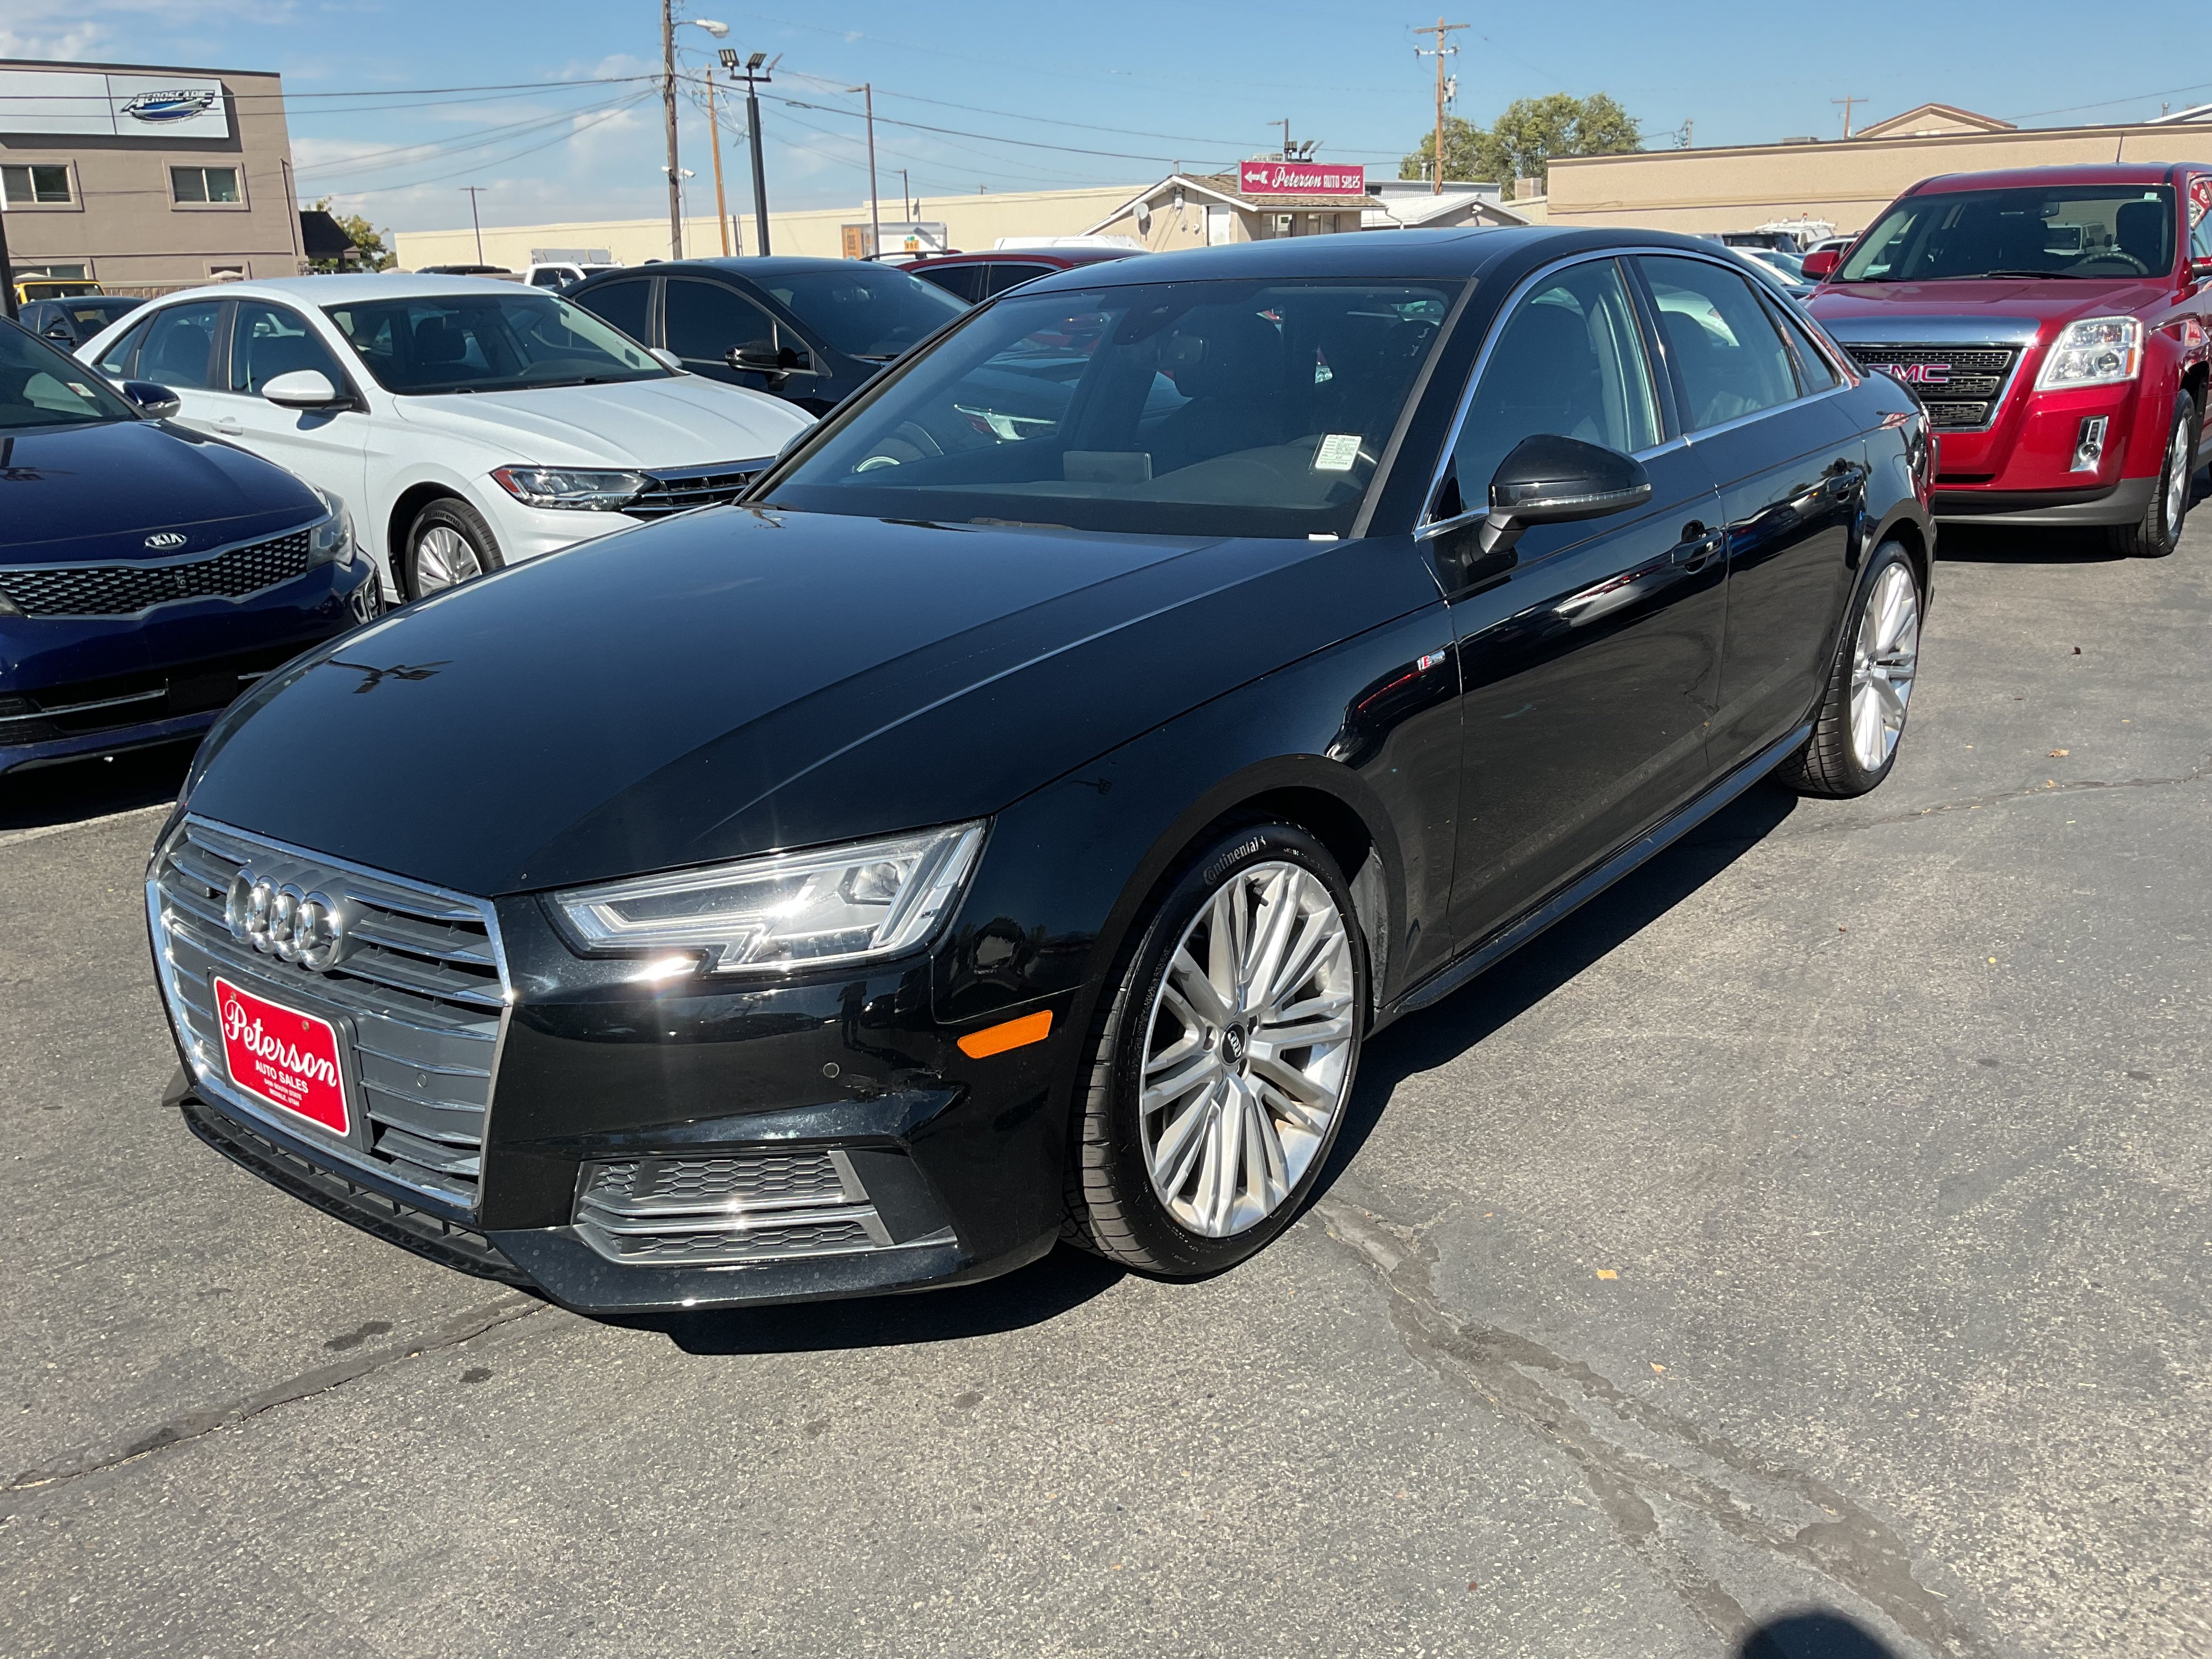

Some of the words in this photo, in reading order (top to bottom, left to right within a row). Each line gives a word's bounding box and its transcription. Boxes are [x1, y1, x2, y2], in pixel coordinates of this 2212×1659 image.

[1272, 166, 1322, 188] Peterson
[1323, 175, 1340, 188] AUTO
[1341, 175, 1361, 189] SALES
[150, 533, 183, 545] KIA
[1203, 836, 1259, 885] Continental
[225, 1000, 337, 1087] Peterson
[256, 1060, 277, 1080] AUTO
[278, 1071, 309, 1093] SALES
